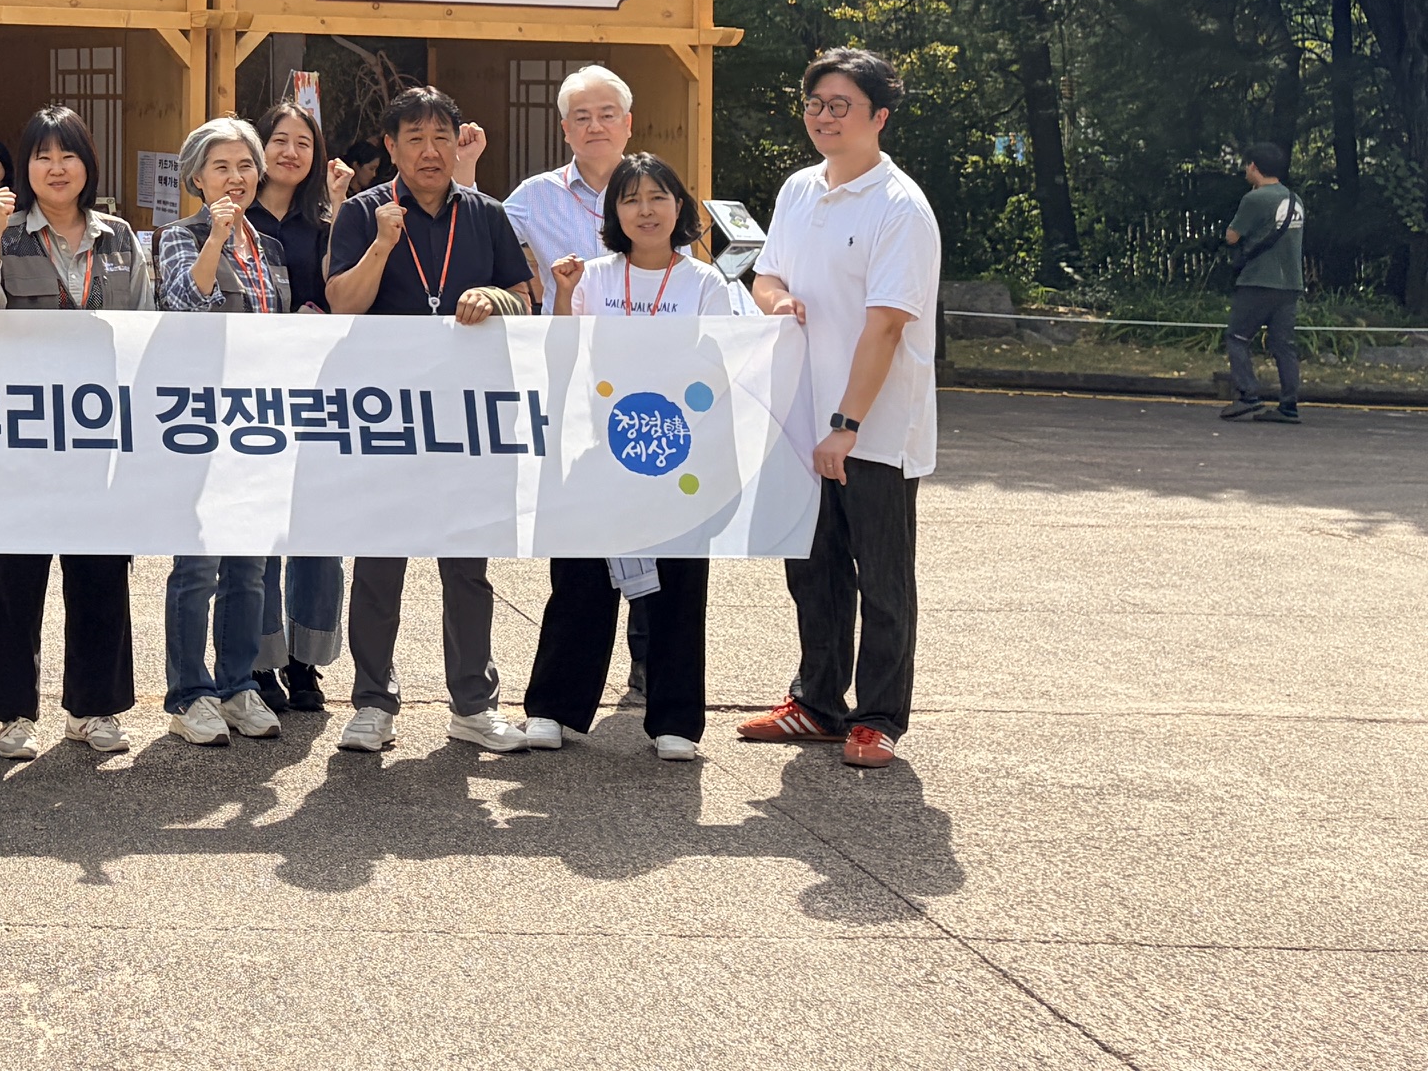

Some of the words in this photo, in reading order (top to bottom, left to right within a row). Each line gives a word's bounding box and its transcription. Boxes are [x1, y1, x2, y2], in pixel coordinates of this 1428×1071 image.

[605, 297, 626, 310] WALK
[630, 301, 653, 313] WALK
[154, 386, 549, 457] 경쟁력입니다
[622, 438, 677, 467] 세상
